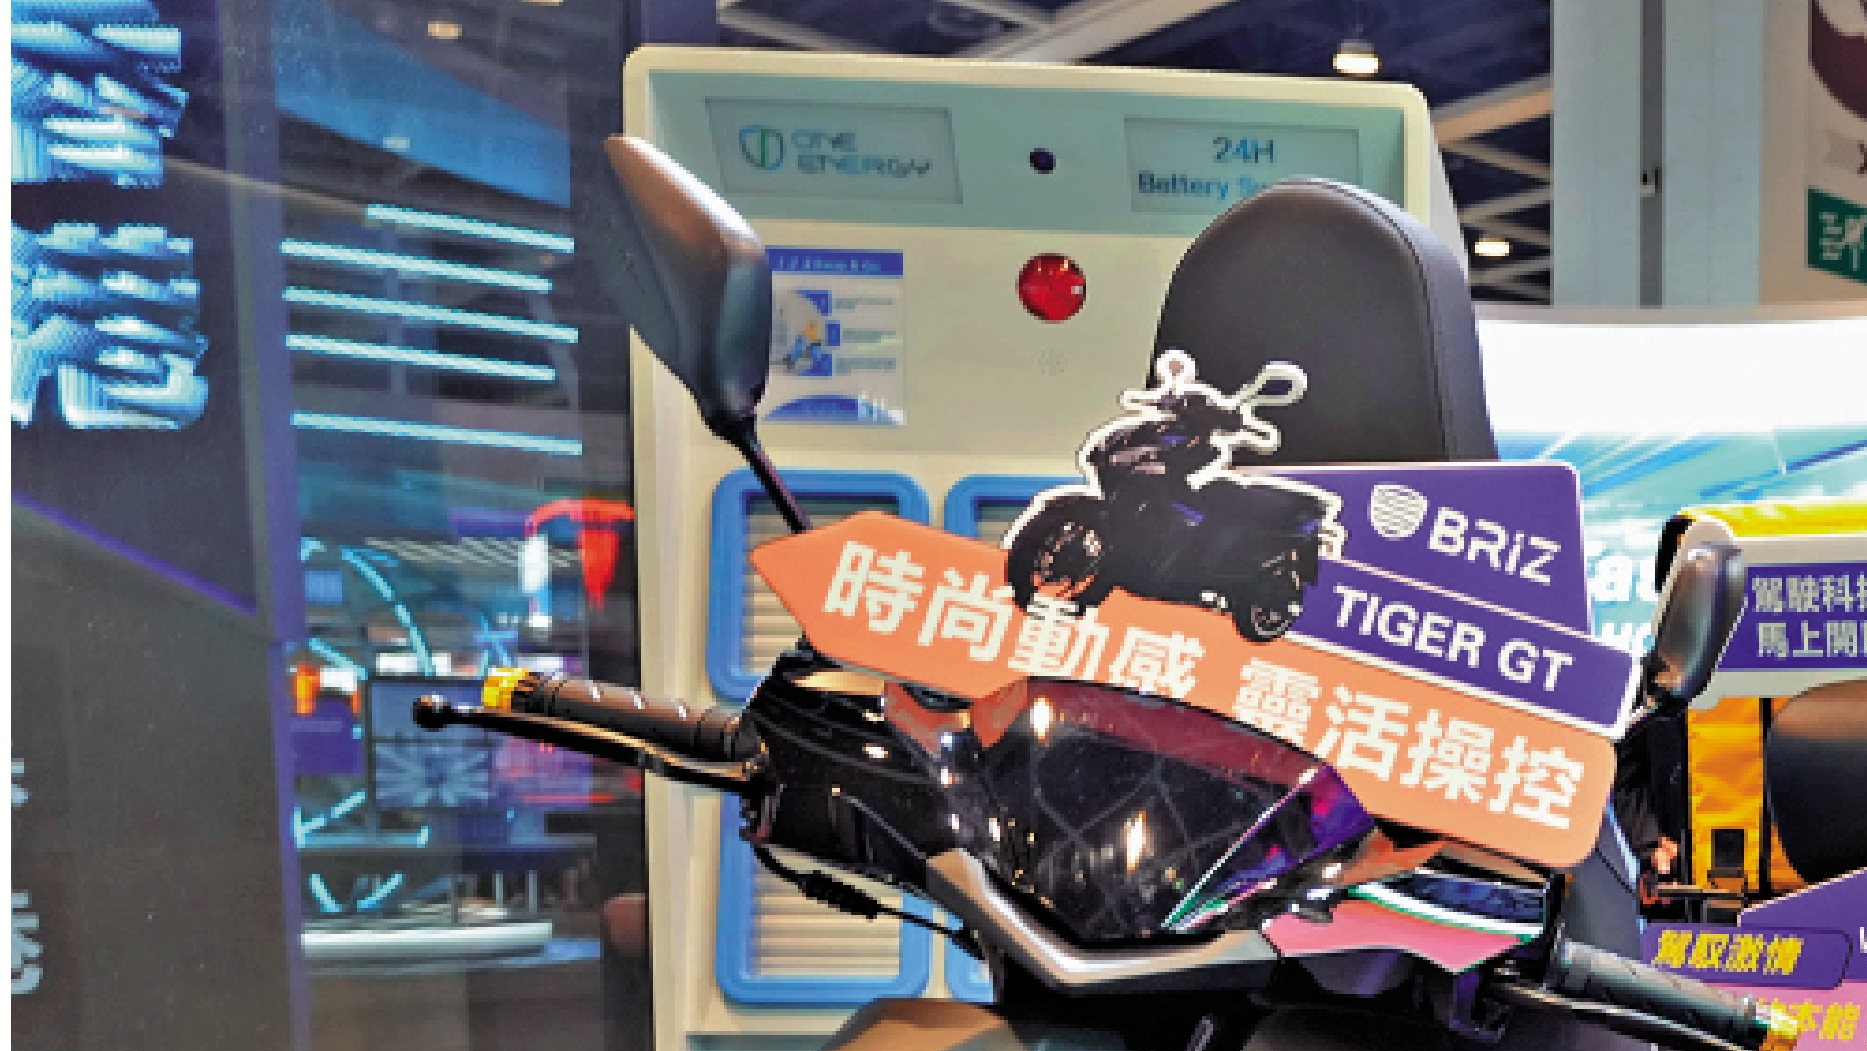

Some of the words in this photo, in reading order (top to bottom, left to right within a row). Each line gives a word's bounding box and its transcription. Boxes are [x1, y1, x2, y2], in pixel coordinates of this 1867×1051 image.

[1212, 136, 1274, 164] 24H
[823, 540, 1208, 699] 時尚動感
[1332, 582, 1487, 668] TIGER
[1496, 637, 1574, 692] GT
